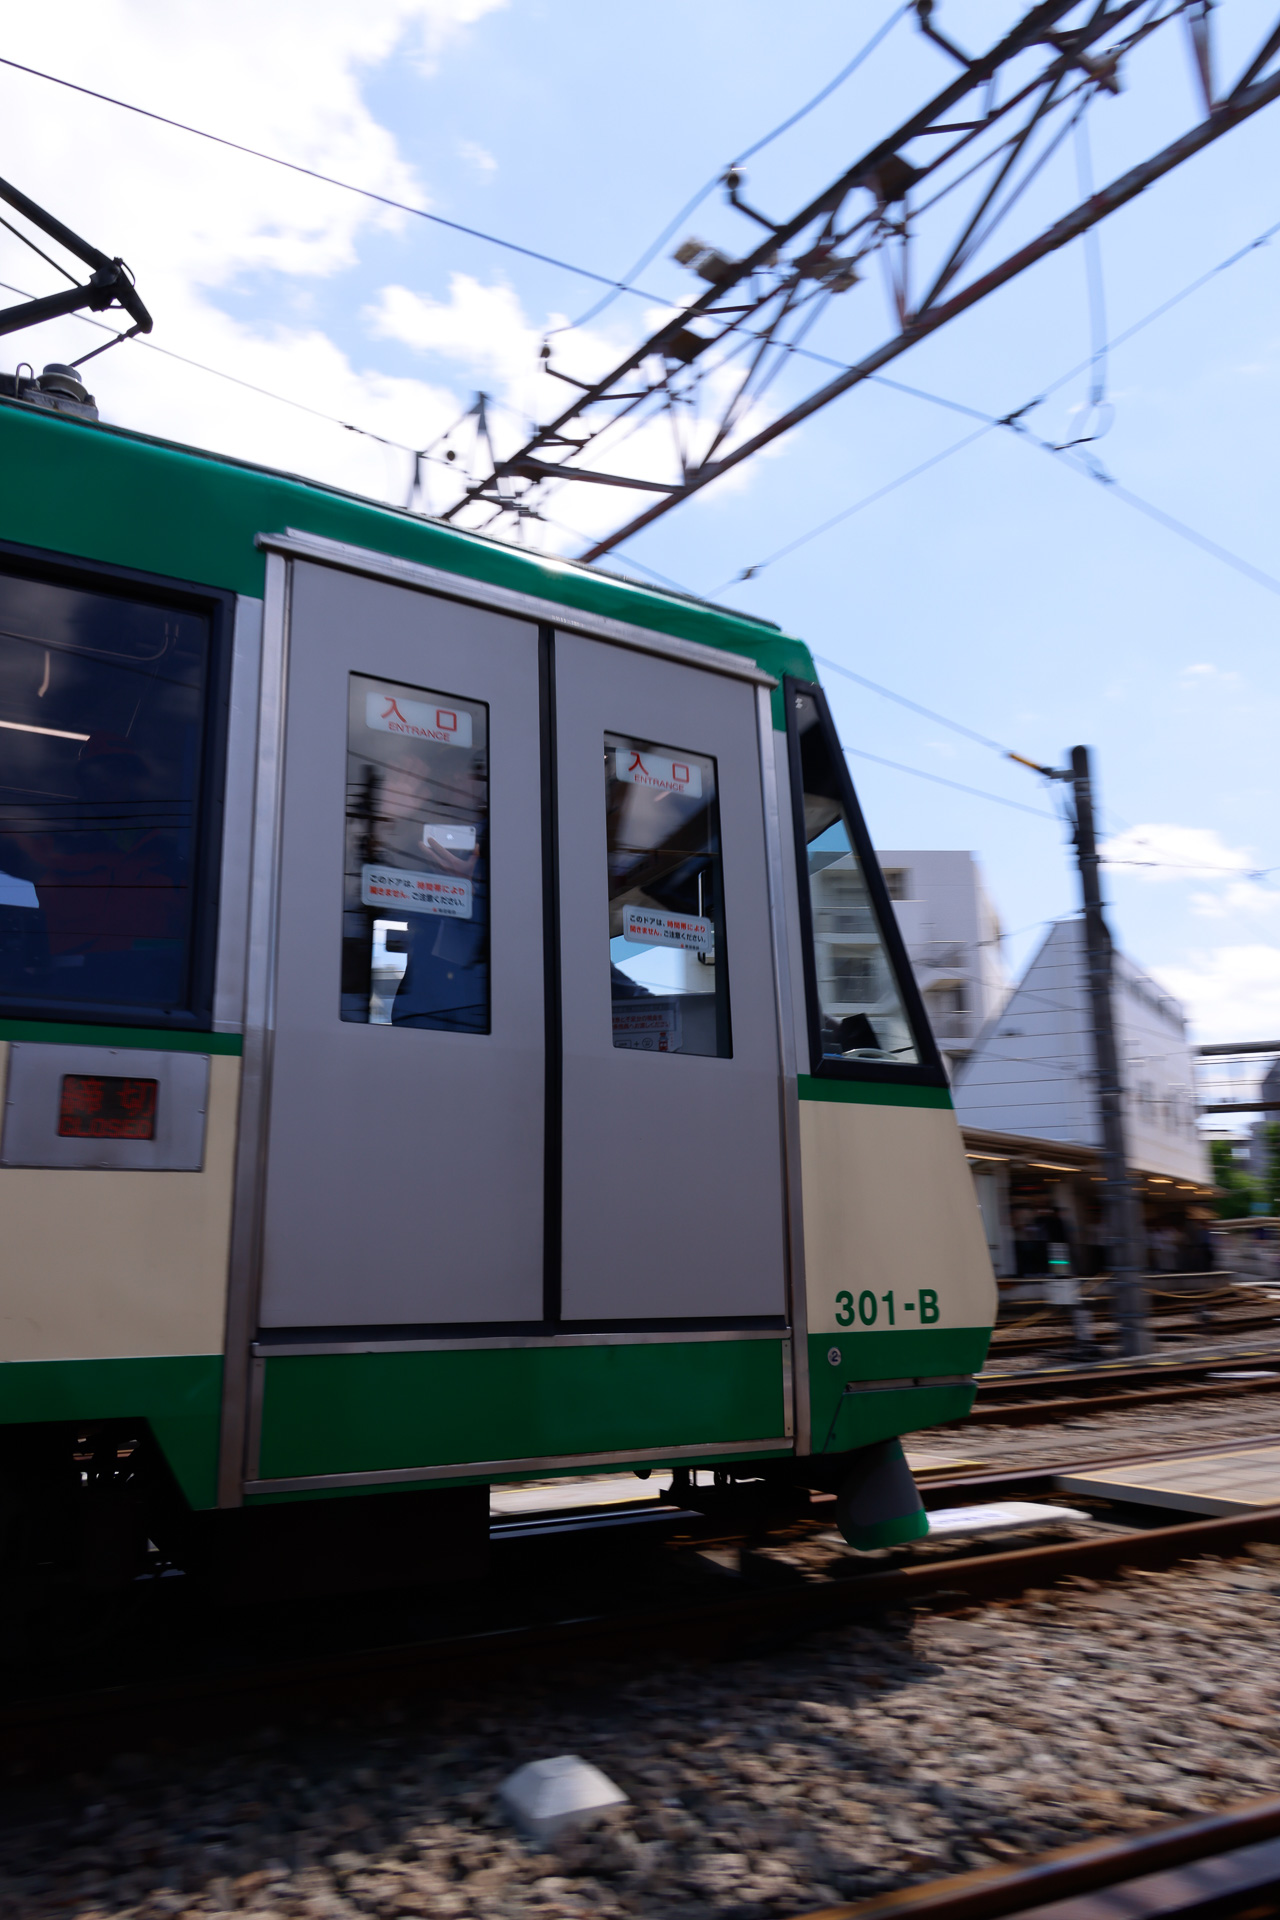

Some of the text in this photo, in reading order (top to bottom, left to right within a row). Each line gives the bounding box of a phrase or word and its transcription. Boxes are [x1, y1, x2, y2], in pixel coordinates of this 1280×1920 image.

[381, 696, 457, 732] 入口
[388, 720, 450, 743] ENTRANCE
[628, 751, 690, 784] 入口
[634, 773, 685, 792] ENTRANCE
[60, 1116, 153, 1140] CLOSED
[834, 1288, 940, 1327] 301-B
